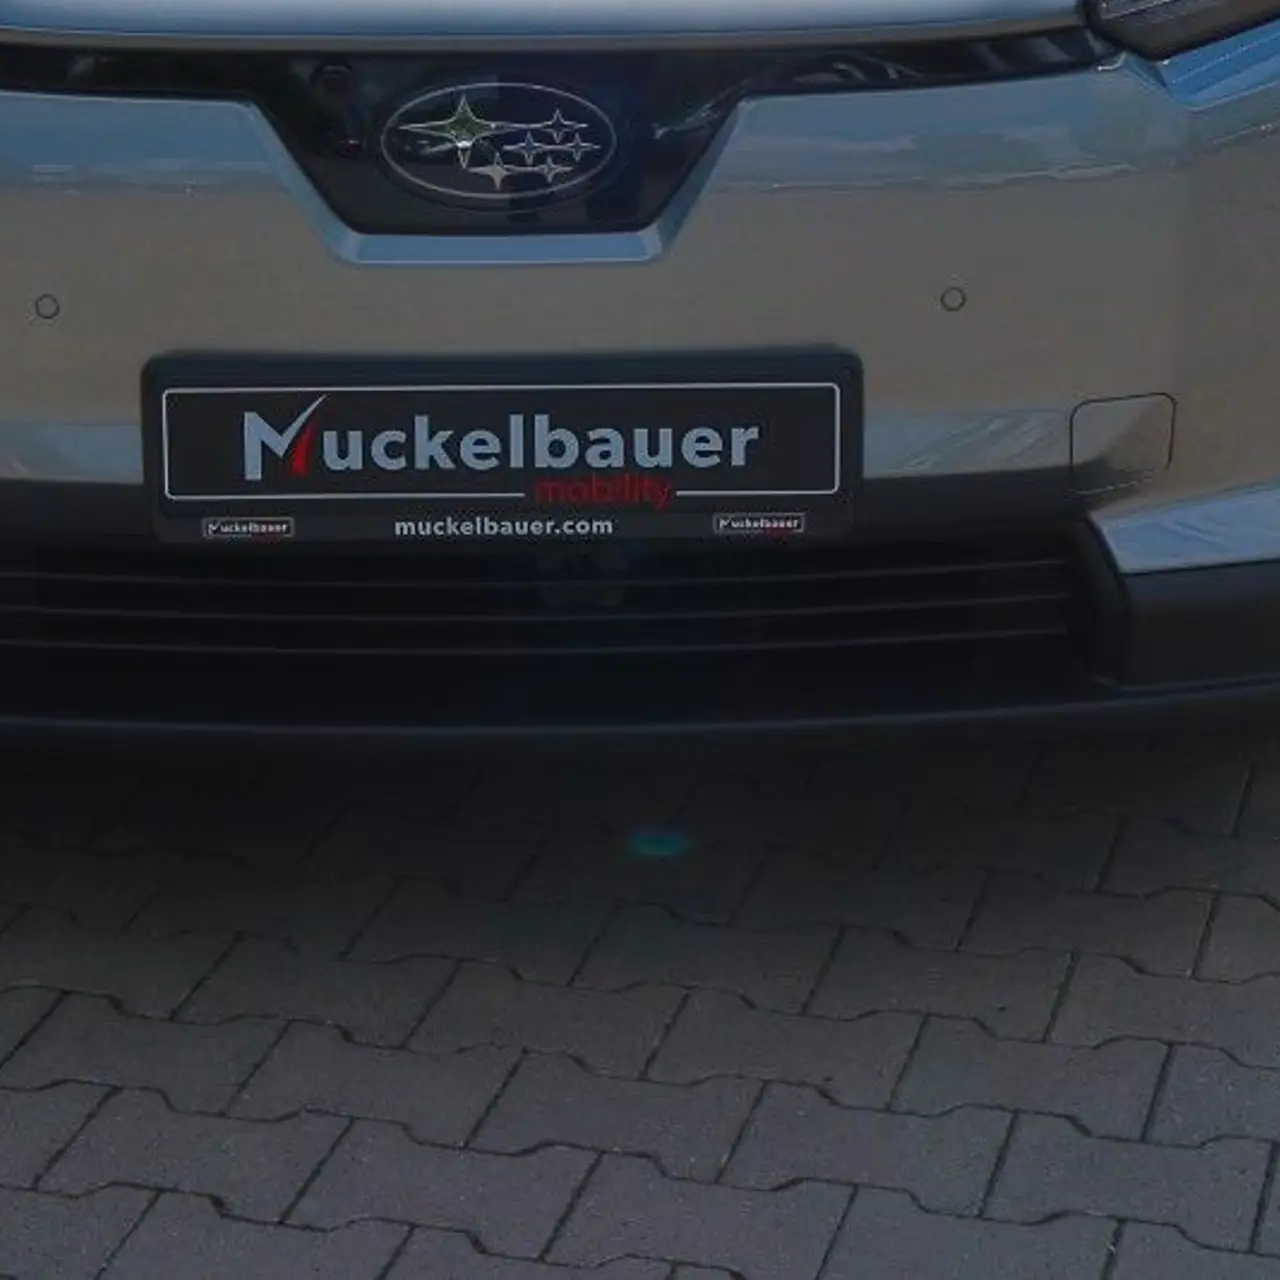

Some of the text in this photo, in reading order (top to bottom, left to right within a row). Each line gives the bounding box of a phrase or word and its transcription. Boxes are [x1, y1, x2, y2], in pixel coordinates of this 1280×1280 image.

[243, 394, 760, 481] Muckelbauer
[534, 472, 672, 511] mobility
[394, 515, 614, 537] muckelbauer.com
